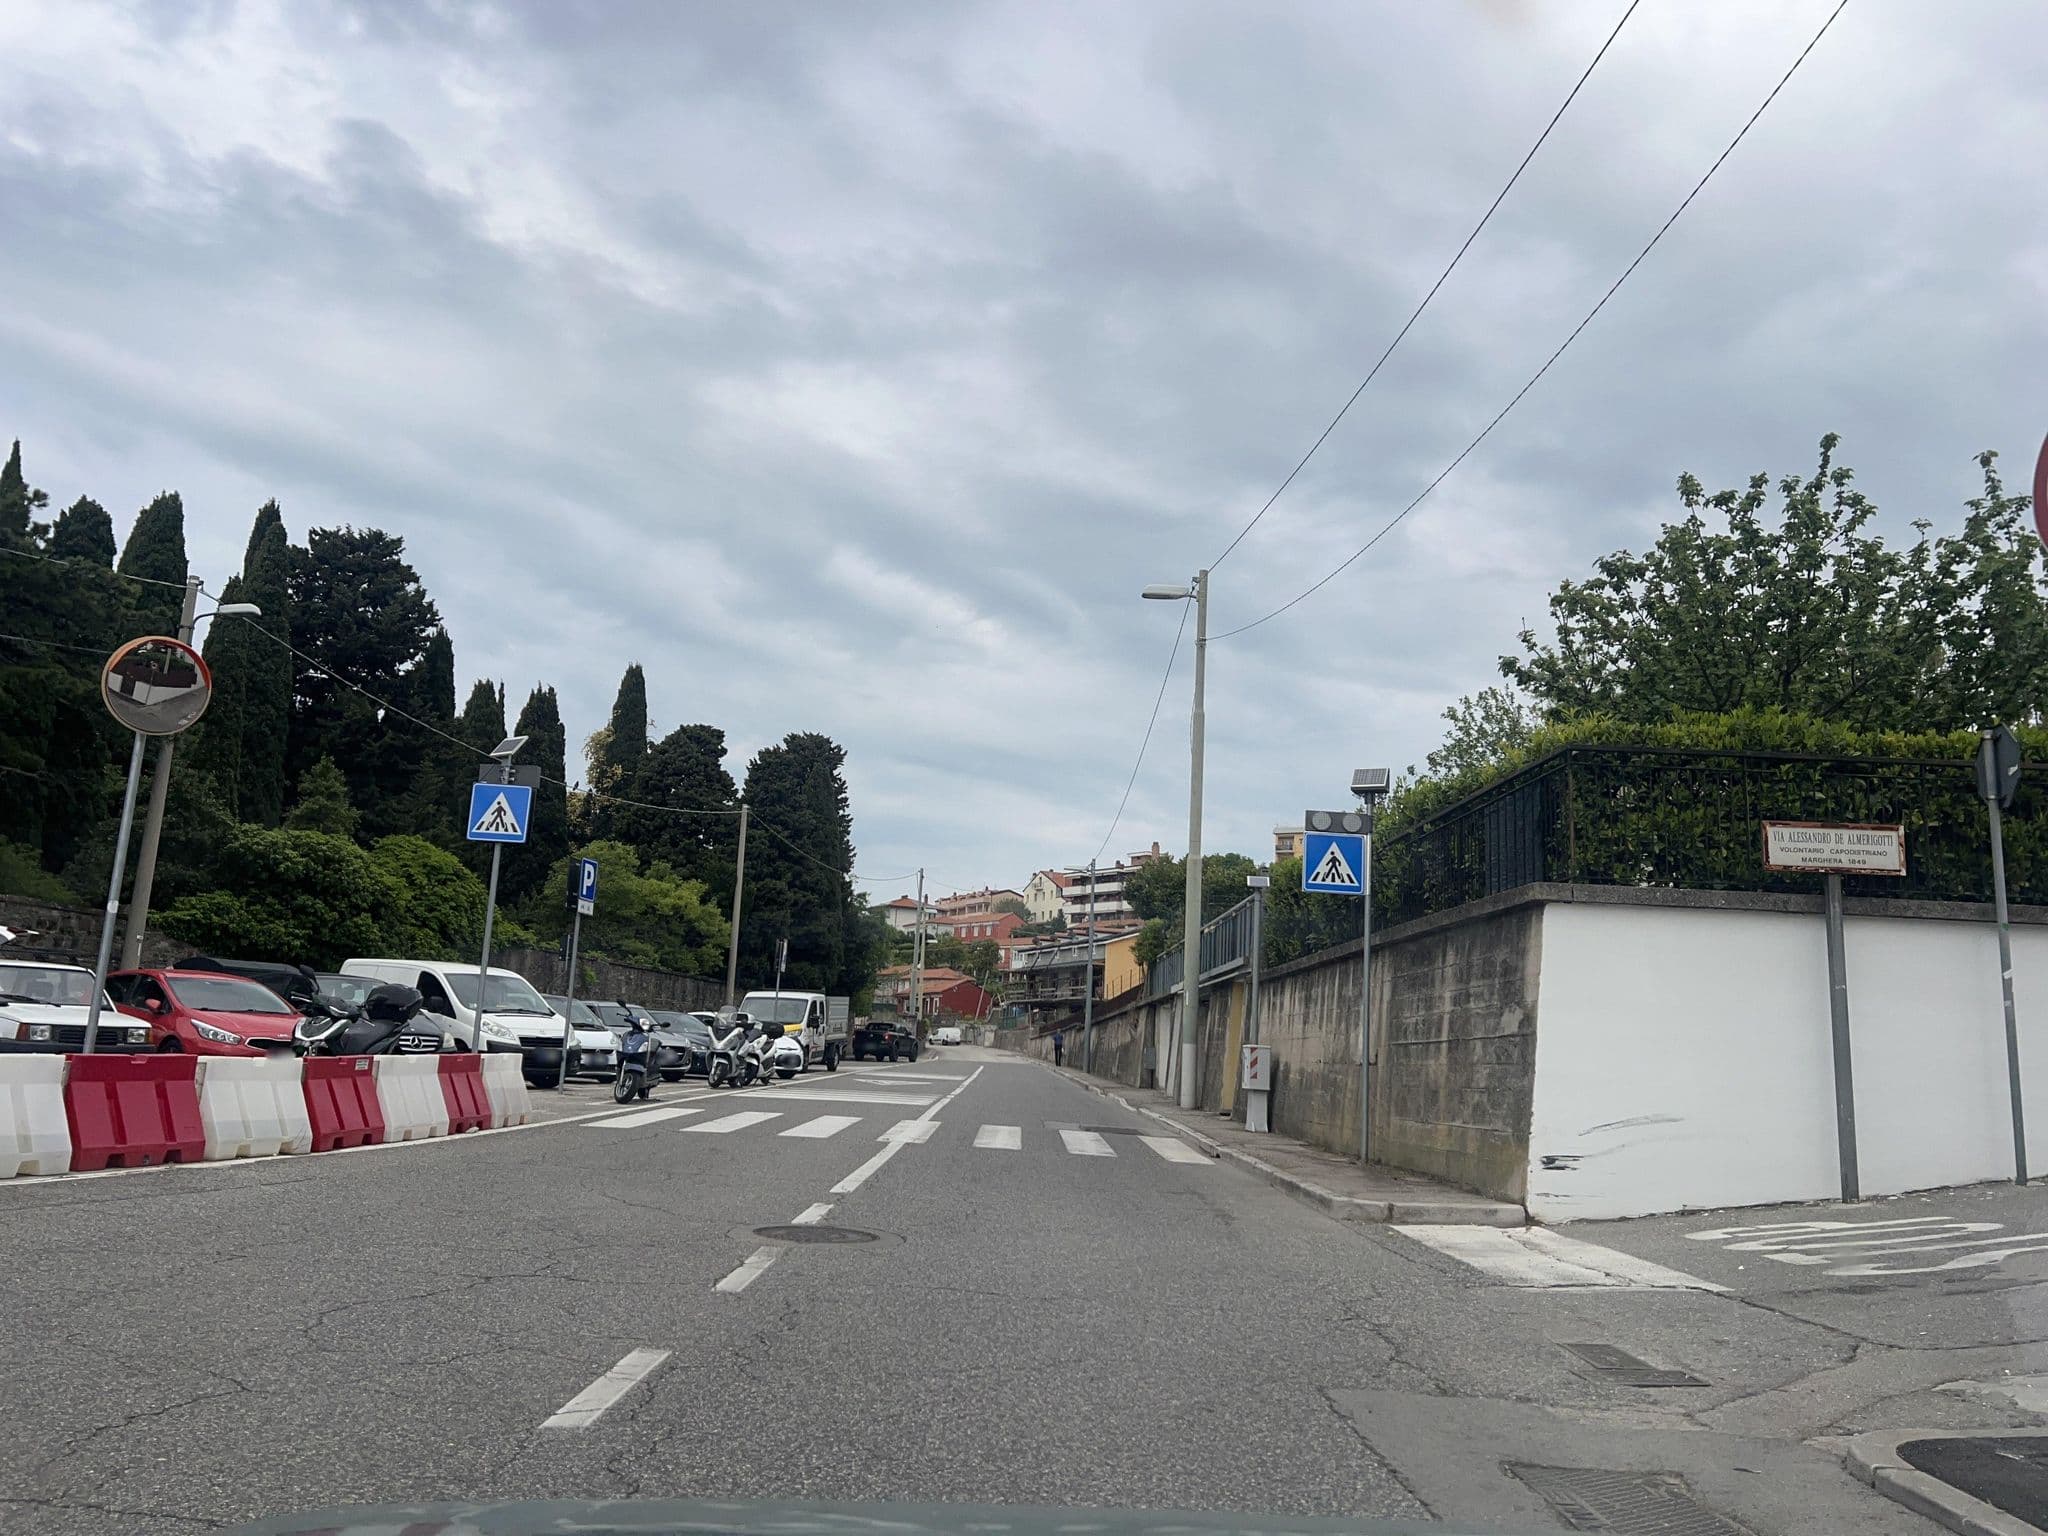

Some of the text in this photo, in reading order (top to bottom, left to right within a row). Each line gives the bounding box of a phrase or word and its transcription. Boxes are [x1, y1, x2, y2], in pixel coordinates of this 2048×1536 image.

[1773, 831, 1893, 847] VIA ALESSANDRO DE ALMERIGOTTI
[1779, 847, 1888, 857] VOLONTARIO CAPODISTRIANO
[1801, 857, 1867, 866] MARGHERA 1849
[583, 863, 595, 895] P
